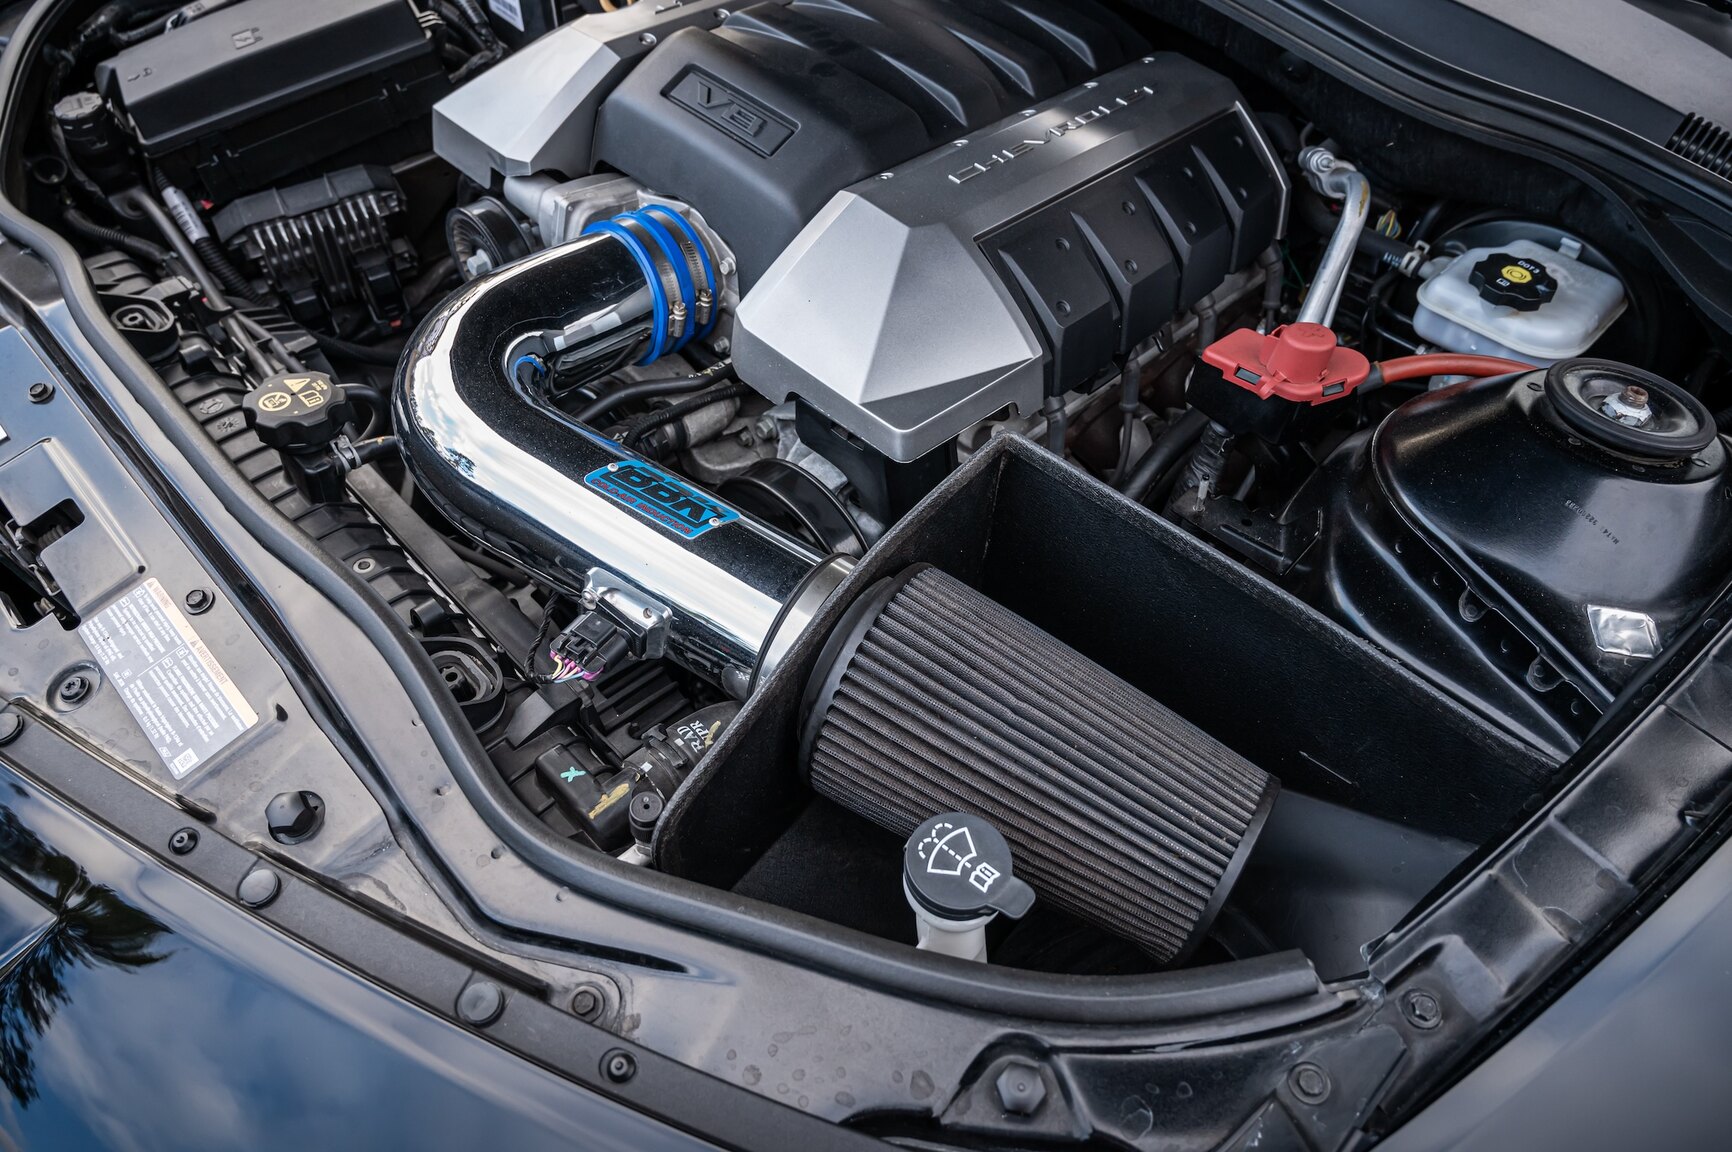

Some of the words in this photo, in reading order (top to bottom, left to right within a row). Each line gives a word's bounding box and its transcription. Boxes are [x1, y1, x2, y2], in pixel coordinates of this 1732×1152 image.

[697, 80, 767, 137] V8
[1517, 260, 1535, 271] DOT
[591, 478, 637, 504] COLD-AIR
[636, 503, 694, 535] INDUCTION
[195, 645, 228, 685] AVERTISSEMENT
[677, 726, 704, 753] RAD
